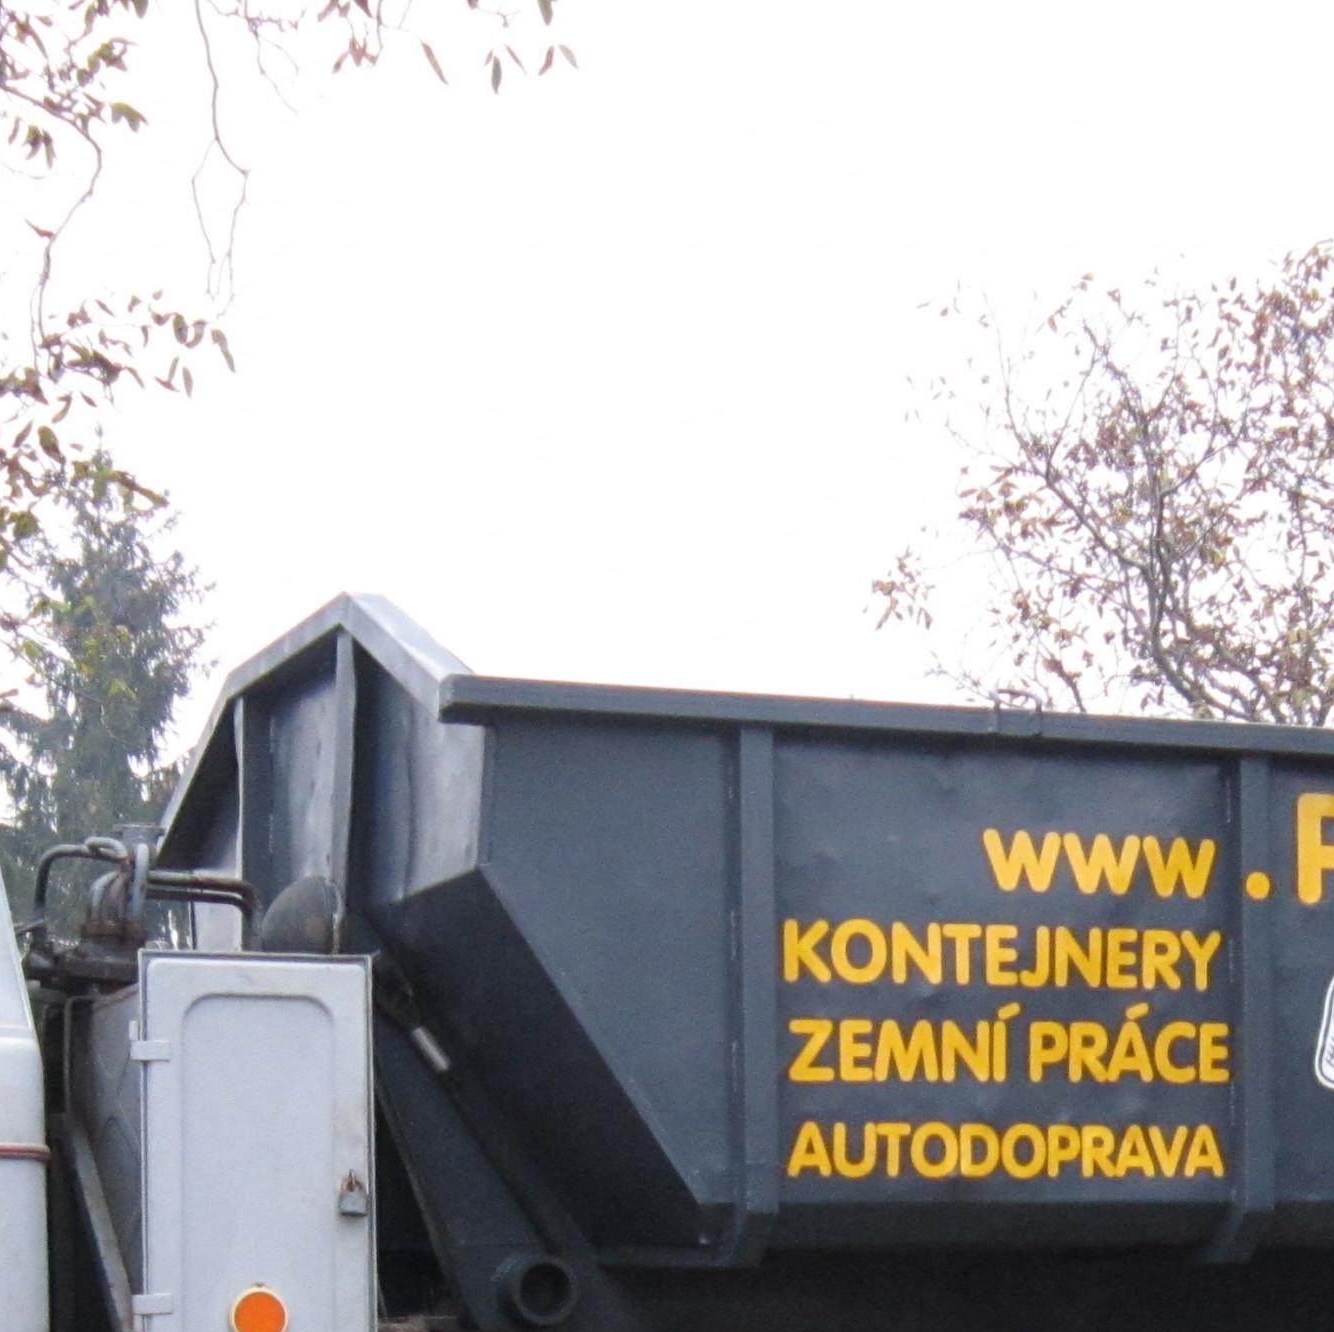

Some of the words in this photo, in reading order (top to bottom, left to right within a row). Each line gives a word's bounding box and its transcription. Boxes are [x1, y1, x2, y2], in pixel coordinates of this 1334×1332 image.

[782, 918, 1222, 990] KONTEJNERY
[788, 1003, 1020, 1084] ZEMNÍ
[1028, 1003, 1230, 1084] PRÁCE
[786, 1121, 1225, 1180] AUTODOPRAVA
